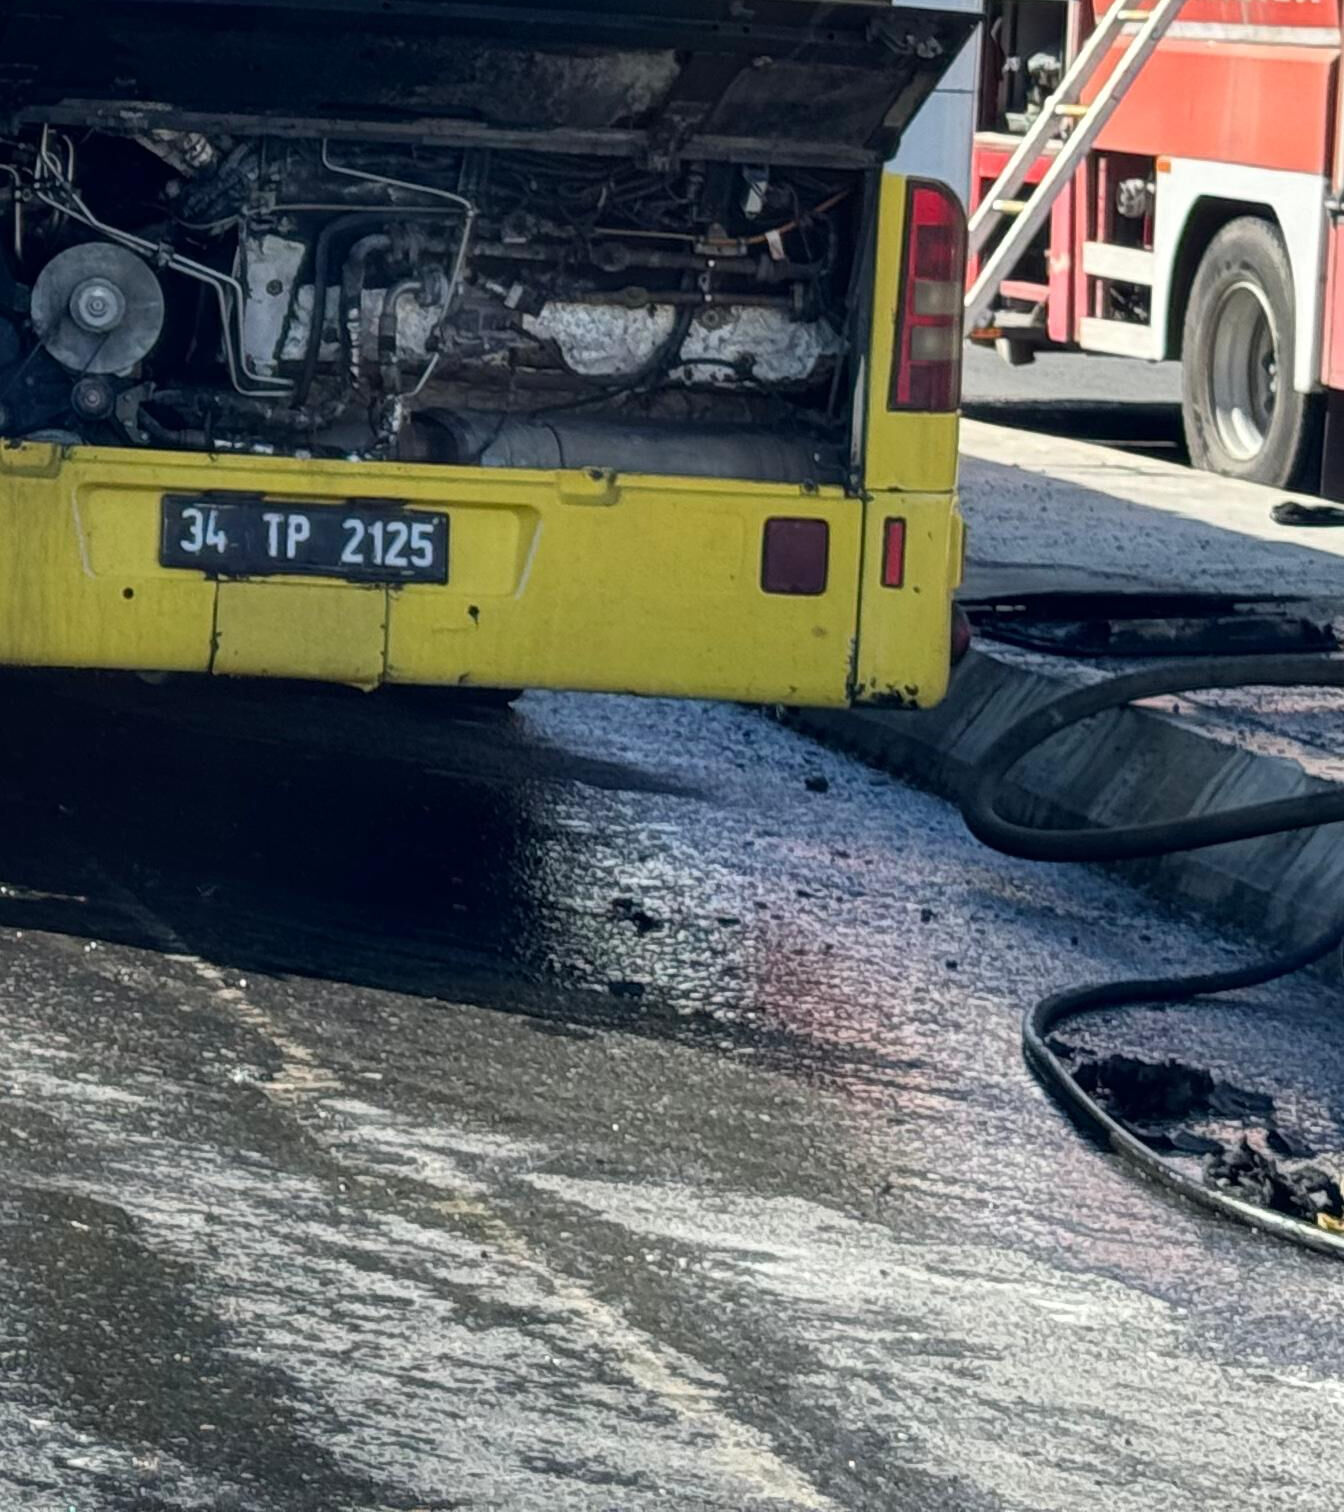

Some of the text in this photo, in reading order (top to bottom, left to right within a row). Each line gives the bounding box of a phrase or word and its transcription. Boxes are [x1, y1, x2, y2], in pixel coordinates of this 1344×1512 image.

[180, 508, 435, 568] 34 TP 2125
